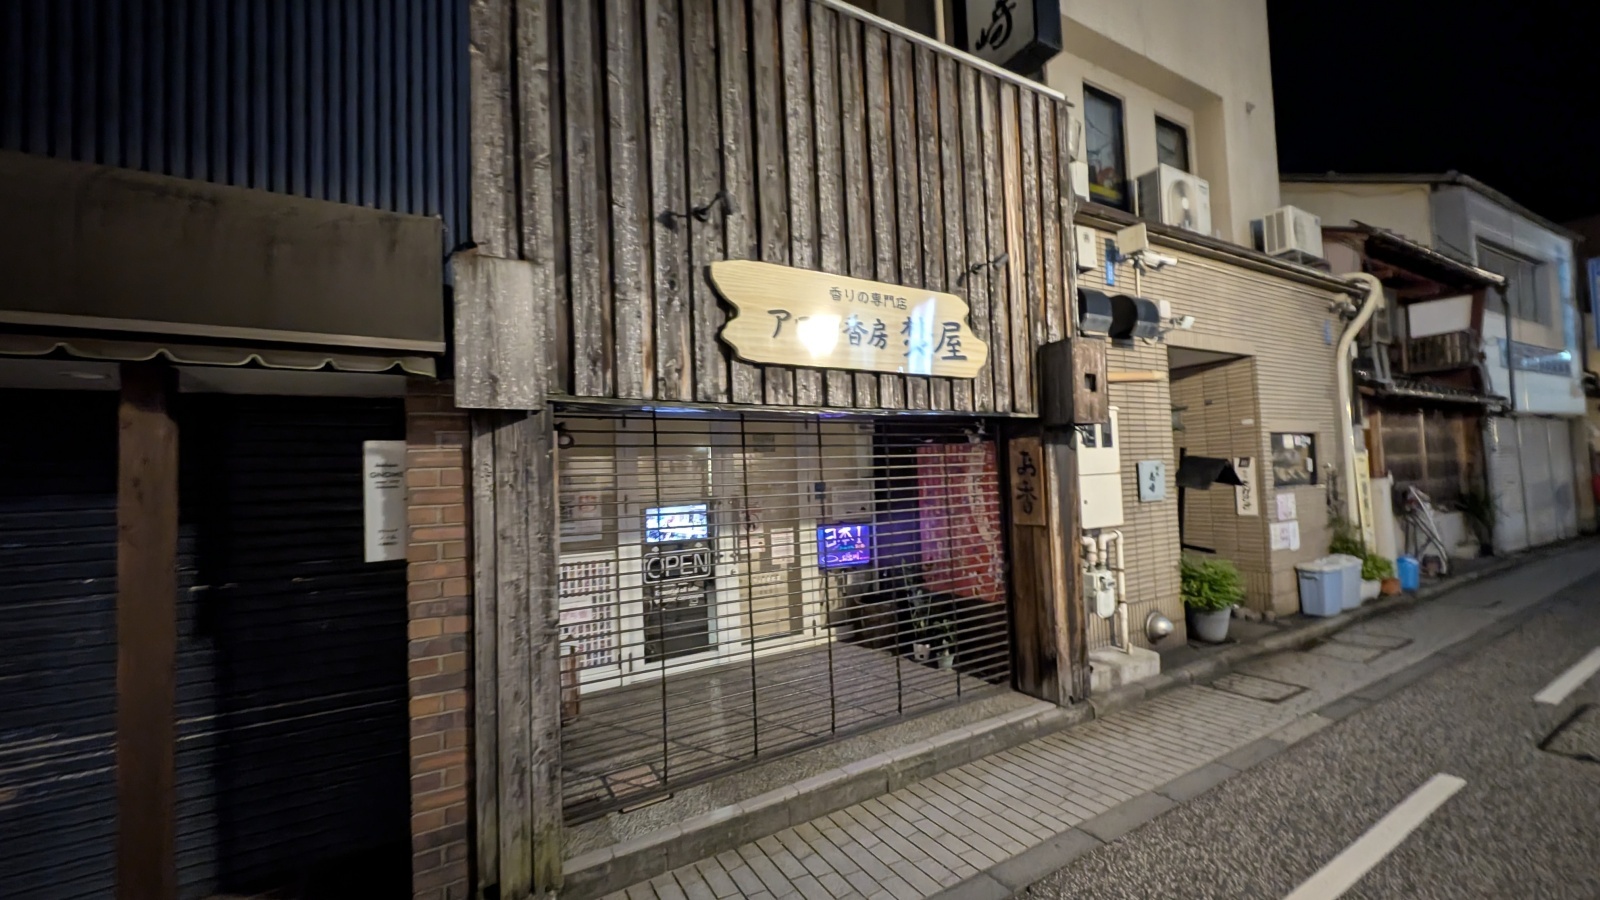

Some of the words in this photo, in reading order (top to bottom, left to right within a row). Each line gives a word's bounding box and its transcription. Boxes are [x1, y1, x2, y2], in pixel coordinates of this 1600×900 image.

[829, 286, 908, 311] 香りの専門店
[647, 553, 708, 579] OPEN
